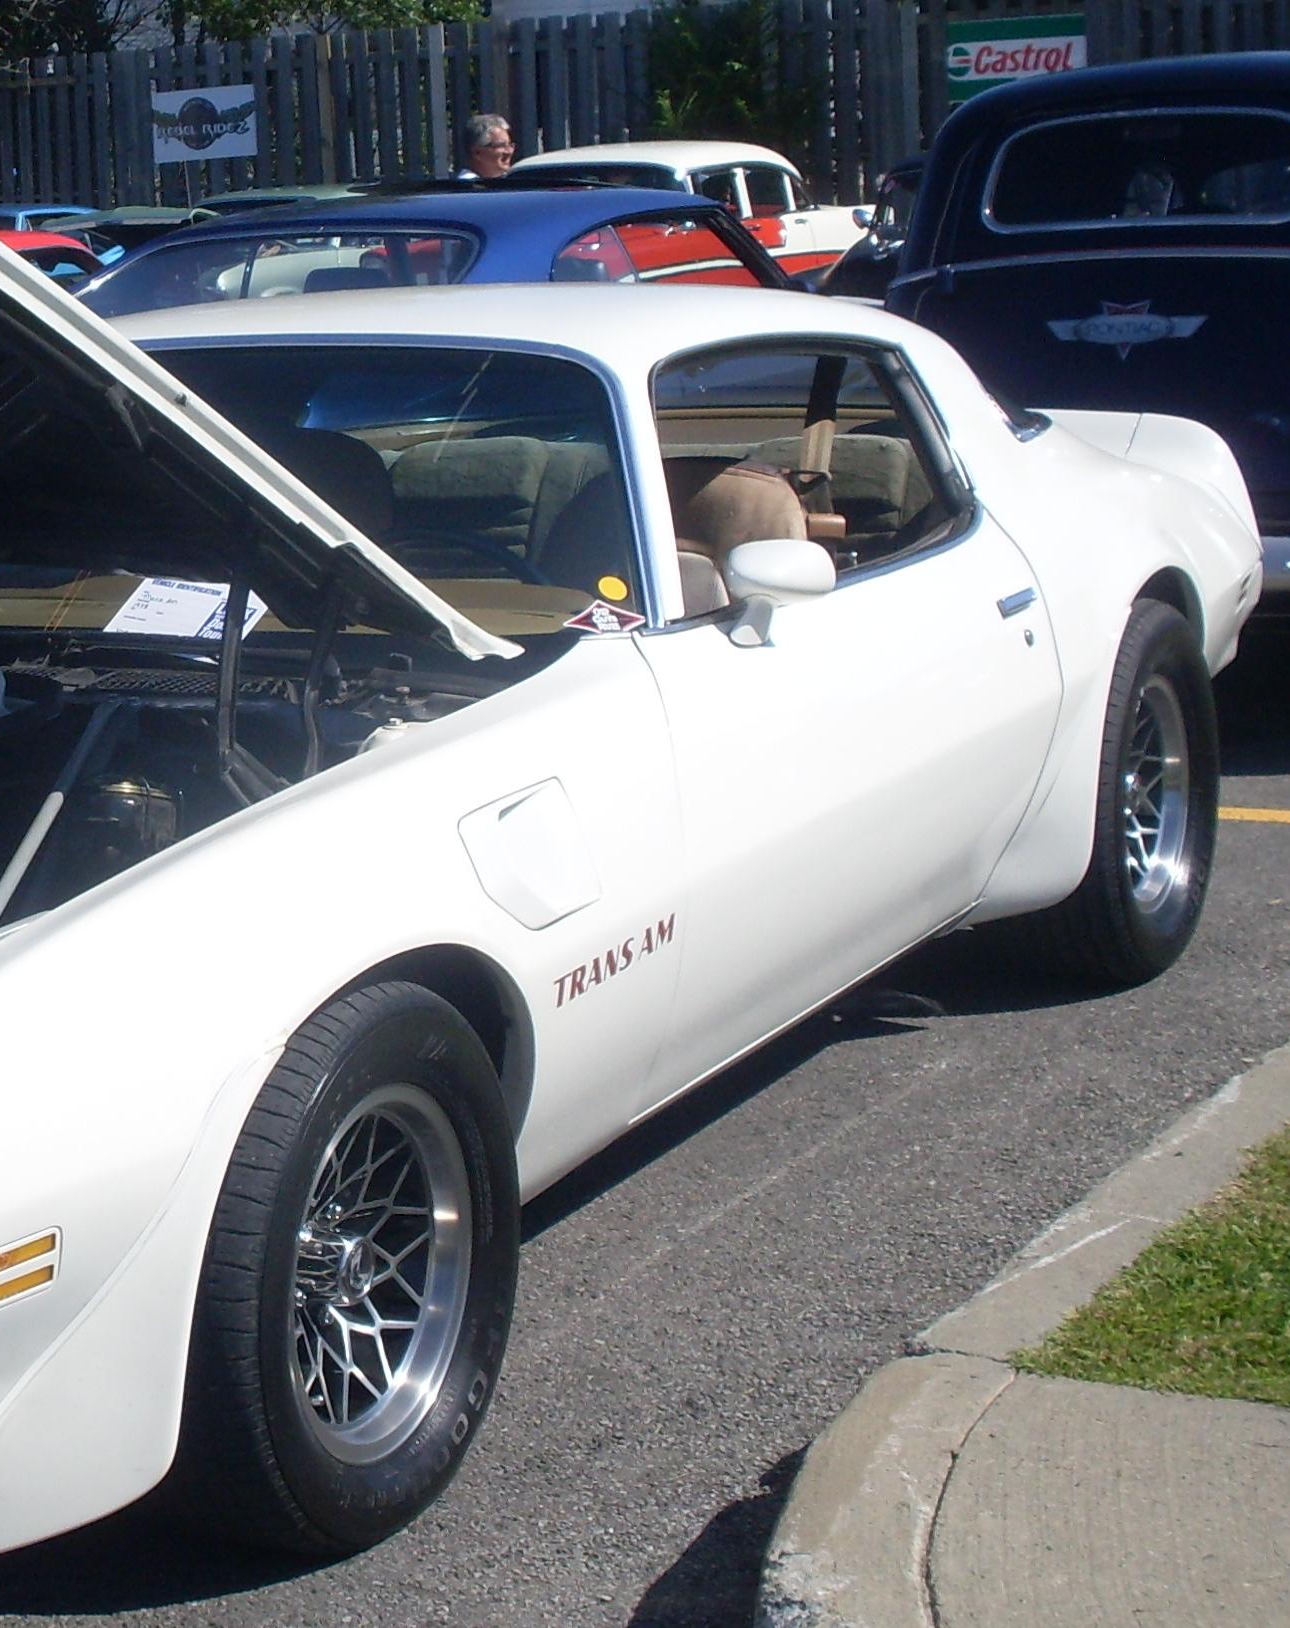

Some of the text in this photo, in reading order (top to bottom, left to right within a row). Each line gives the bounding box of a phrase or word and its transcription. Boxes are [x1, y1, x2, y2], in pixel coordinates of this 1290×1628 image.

[974, 41, 1074, 75] Castrol
[176, 583, 223, 597] IDENTIFICATION
[554, 912, 675, 1008] TRANS AM
